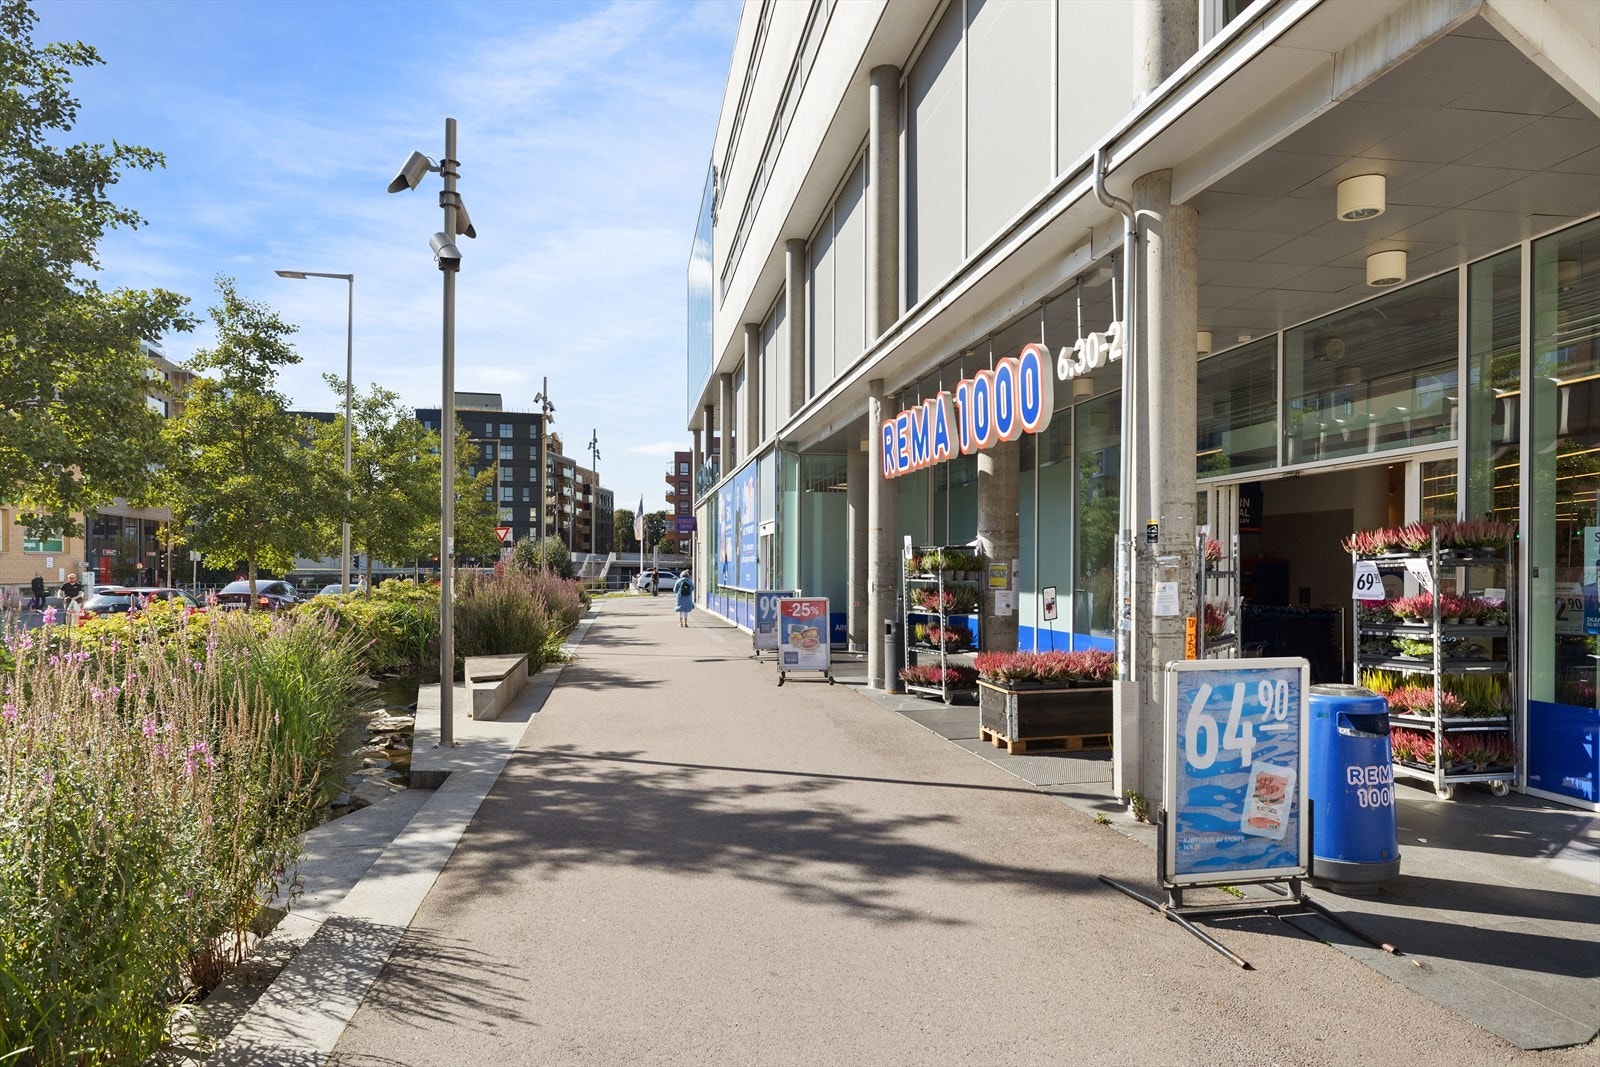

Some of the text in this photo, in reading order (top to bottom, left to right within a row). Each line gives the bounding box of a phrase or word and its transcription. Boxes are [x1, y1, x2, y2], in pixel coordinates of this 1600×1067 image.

[883, 343, 1042, 477] REMA 1000
[1357, 573, 1374, 591] 69
[788, 602, 820, 617] -25%
[1185, 682, 1256, 770] 64
